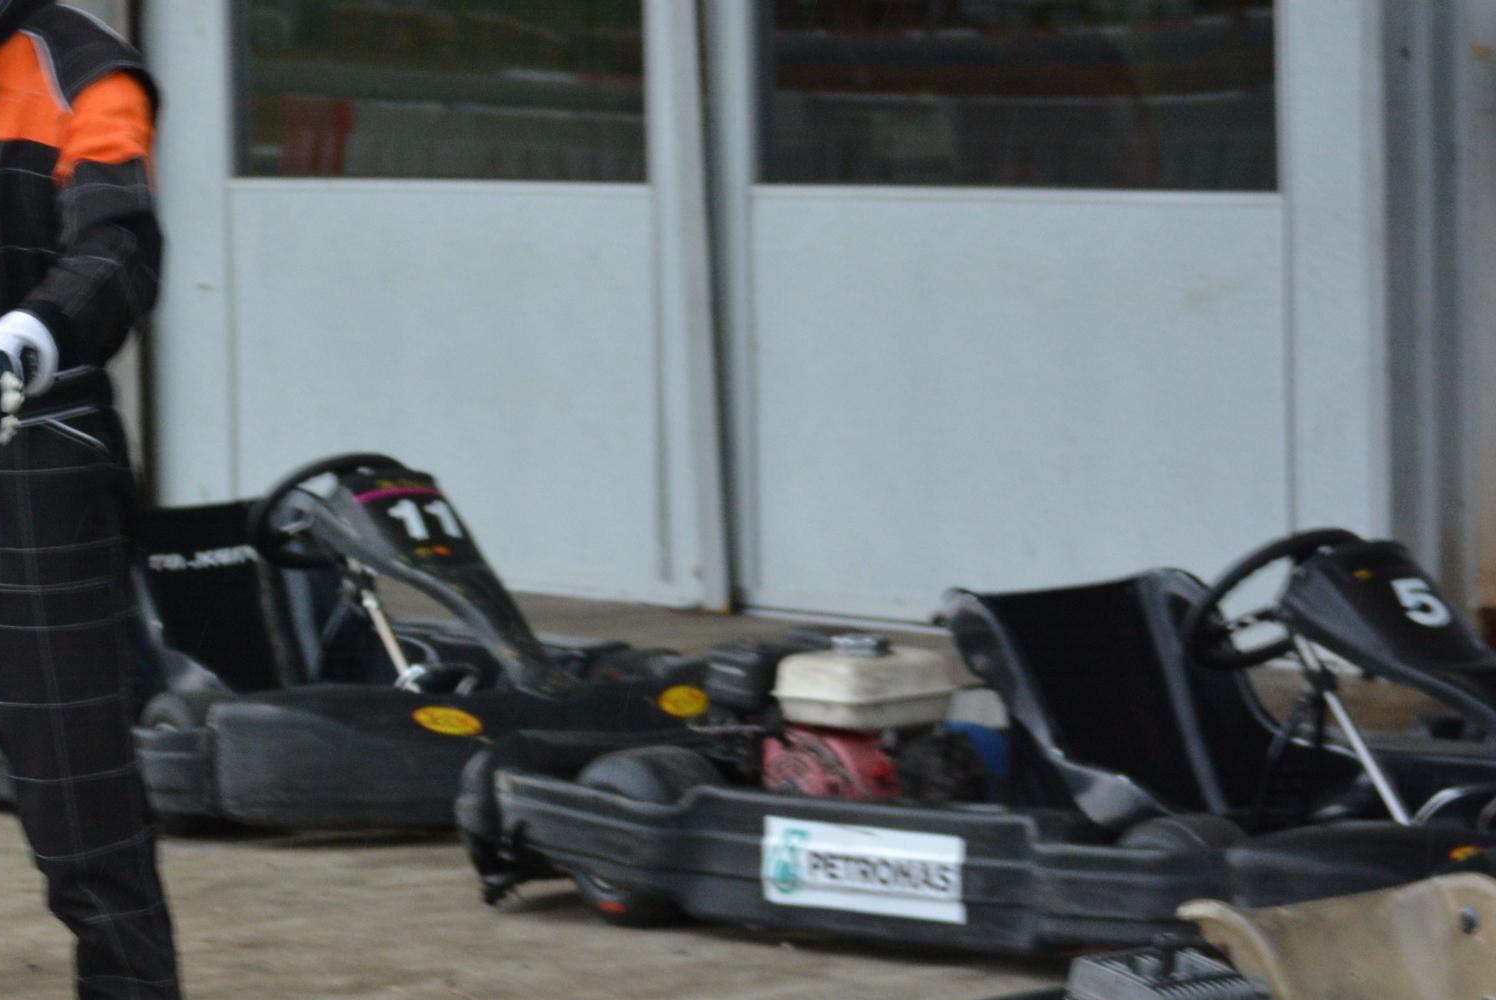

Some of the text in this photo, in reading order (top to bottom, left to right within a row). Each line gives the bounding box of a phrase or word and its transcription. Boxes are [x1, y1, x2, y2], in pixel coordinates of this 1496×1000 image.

[386, 498, 464, 542] 11
[1389, 576, 1452, 628] 5
[807, 851, 958, 893] PETRONAS
